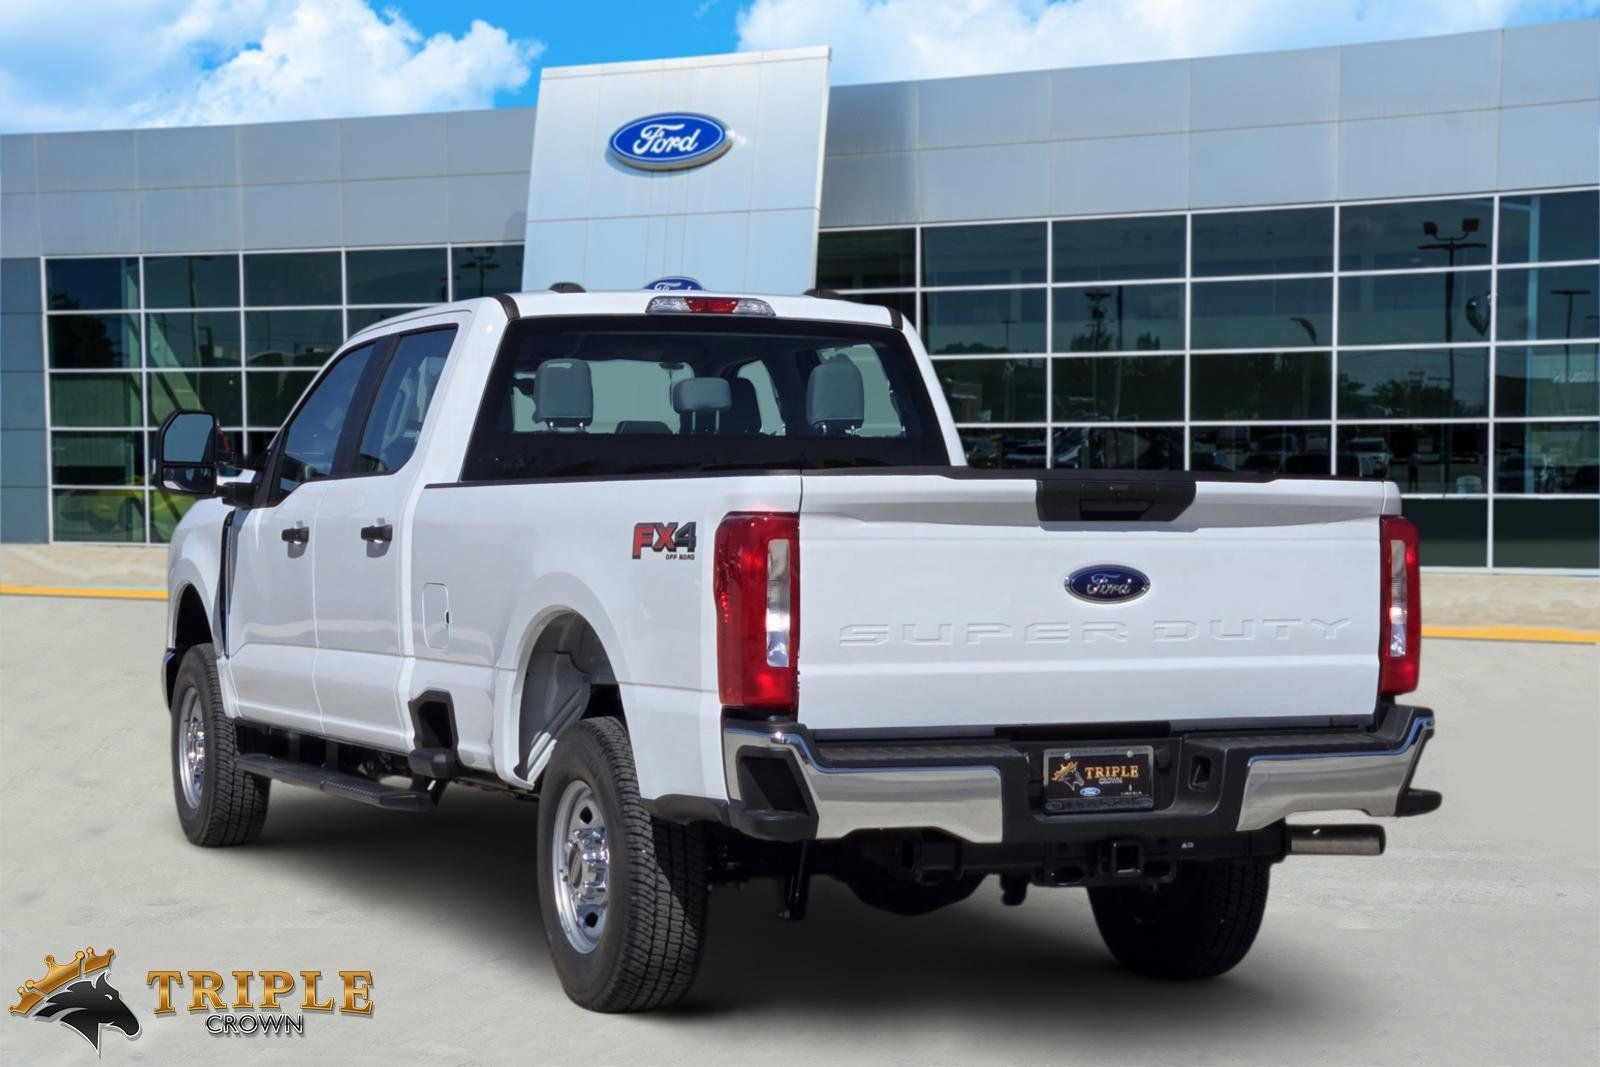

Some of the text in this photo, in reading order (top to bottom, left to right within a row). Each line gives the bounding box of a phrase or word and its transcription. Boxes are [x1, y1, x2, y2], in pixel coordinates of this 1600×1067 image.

[632, 123, 702, 155] Ford
[631, 521, 697, 560] FX4
[1086, 573, 1132, 595] Ford
[839, 617, 1352, 646] SUPER DUTY
[1084, 765, 1140, 780] TRIPLE
